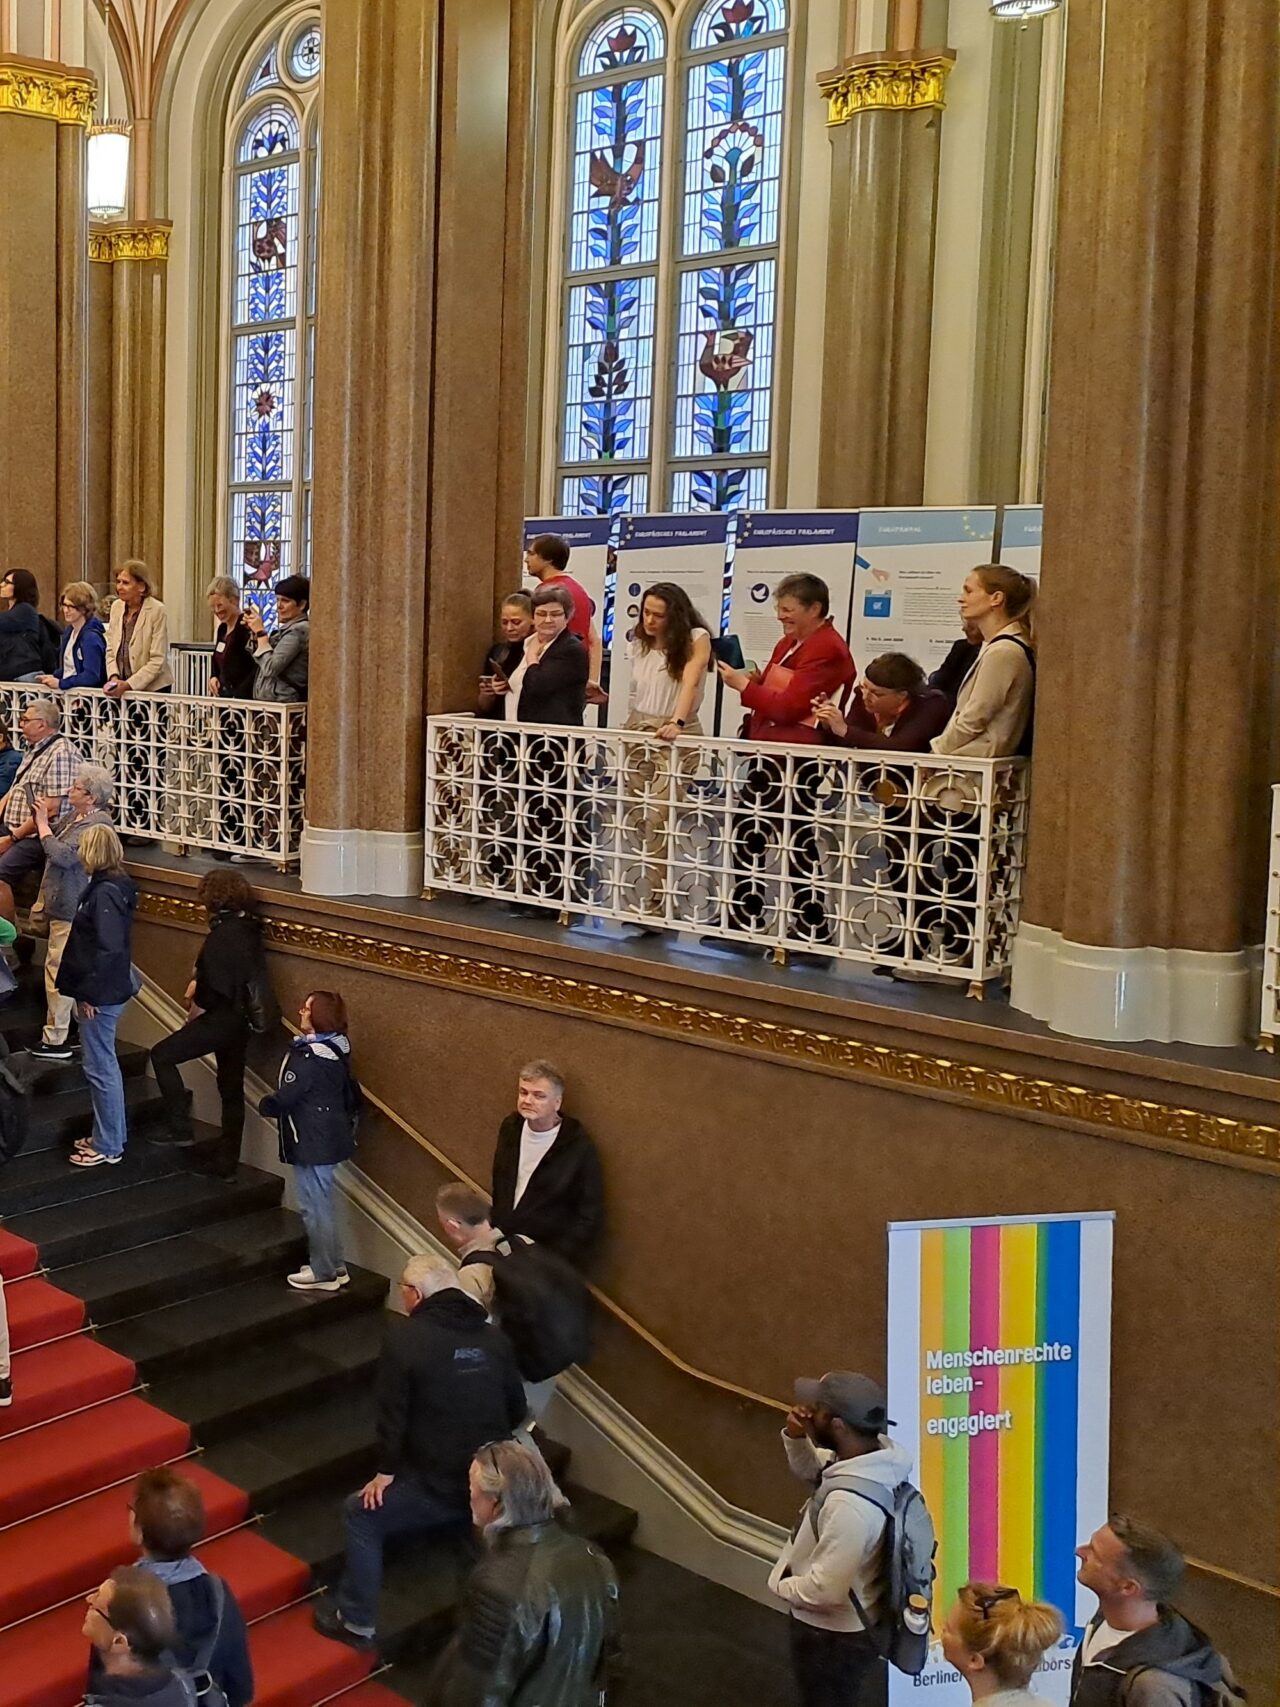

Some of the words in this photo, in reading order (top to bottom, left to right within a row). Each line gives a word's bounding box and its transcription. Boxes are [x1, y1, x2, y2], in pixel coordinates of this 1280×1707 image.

[926, 1342, 1072, 1369] Menschenrechte
[926, 1410, 1011, 1438] engagiert
[913, 1670, 963, 1687] Berliner
